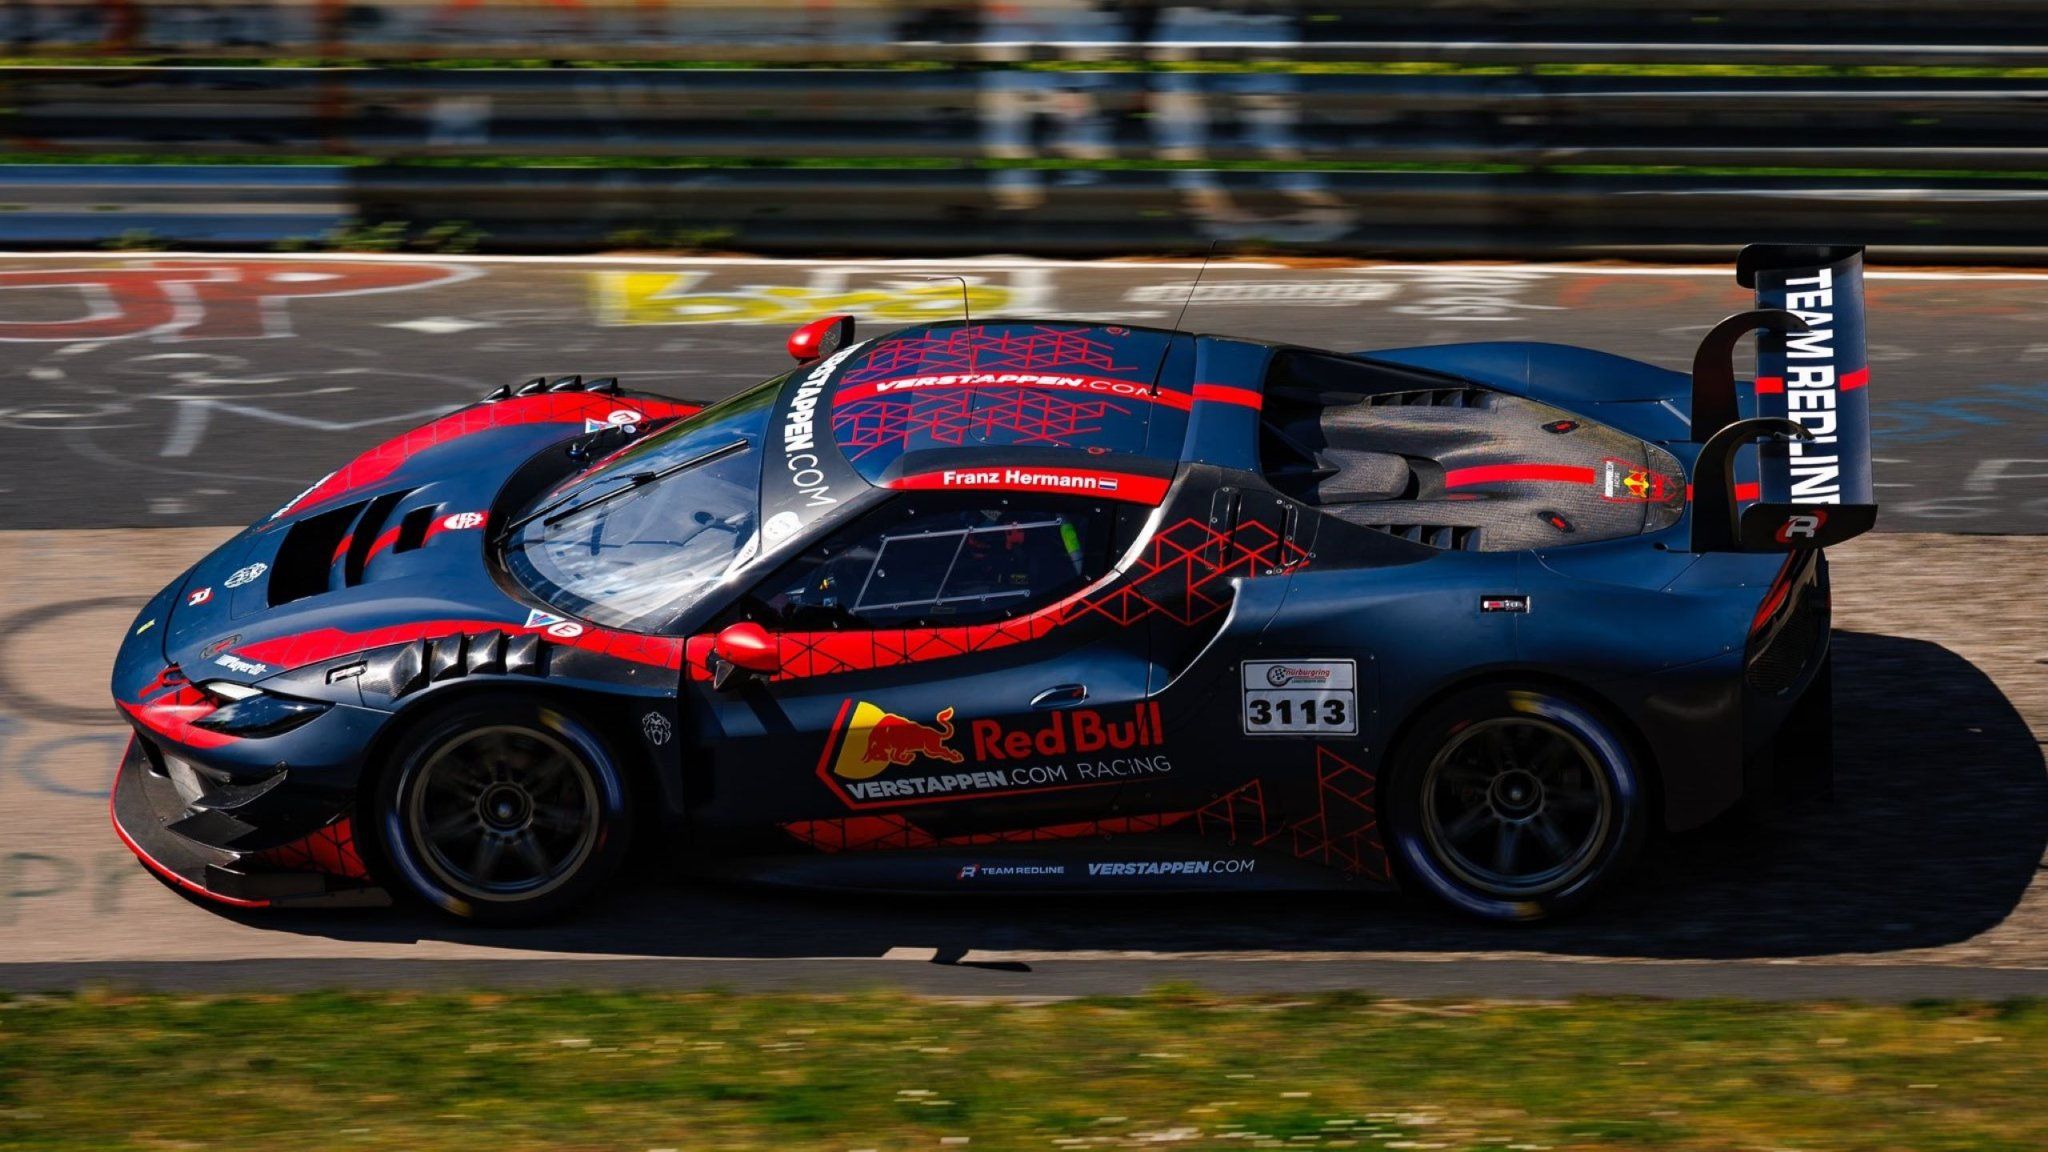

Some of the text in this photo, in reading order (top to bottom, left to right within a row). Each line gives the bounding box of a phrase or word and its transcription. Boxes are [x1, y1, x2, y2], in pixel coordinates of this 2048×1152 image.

[1786, 268, 1841, 505] TEAM REDLIN
[943, 470, 1096, 489] Franz Hermann
[1249, 699, 1346, 726] 3113
[971, 701, 1164, 762] Red Bull
[846, 755, 1172, 800] VERSTAPPEN.COM RACING
[982, 866, 1014, 875] TEAM
[1016, 866, 1065, 874] REDLINE
[1088, 859, 1255, 876] VERSTAPPEN.COM
